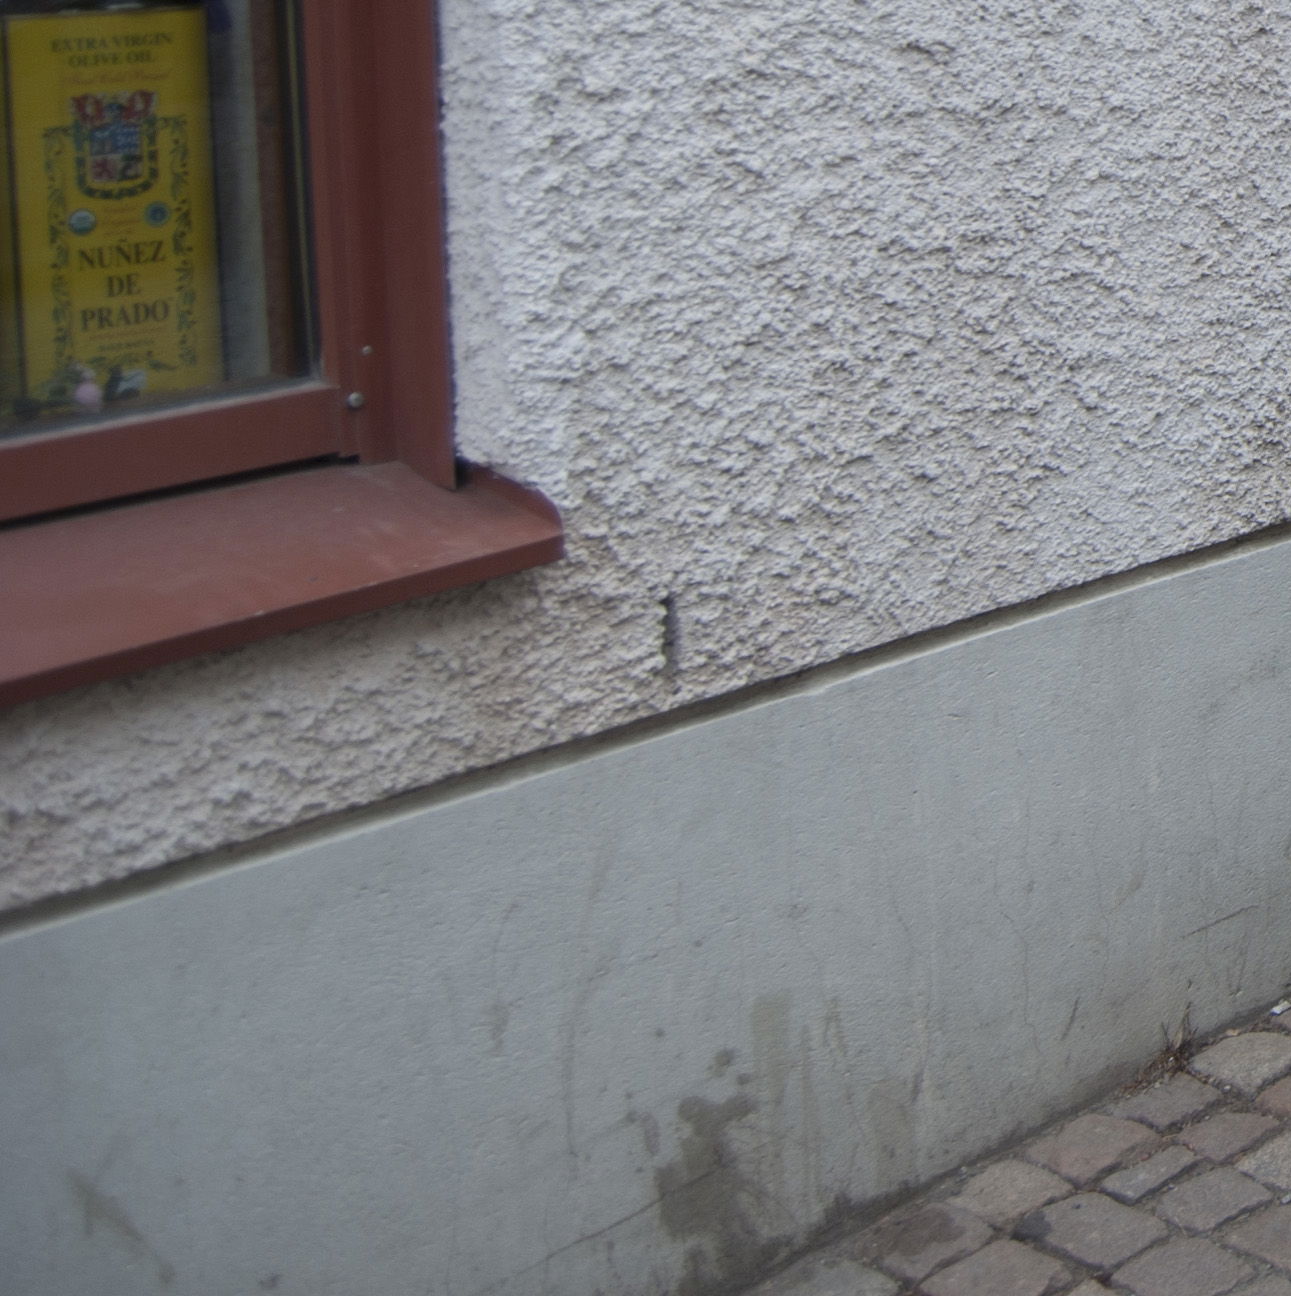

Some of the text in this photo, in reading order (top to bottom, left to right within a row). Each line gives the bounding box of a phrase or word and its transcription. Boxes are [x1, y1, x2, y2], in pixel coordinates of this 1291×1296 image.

[50, 31, 174, 53] EXTRA VIRGIN
[68, 49, 154, 68] OLIVE OIL
[78, 237, 166, 271] NUÑEZ
[107, 272, 141, 298] DE
[80, 299, 170, 332] PRADO
